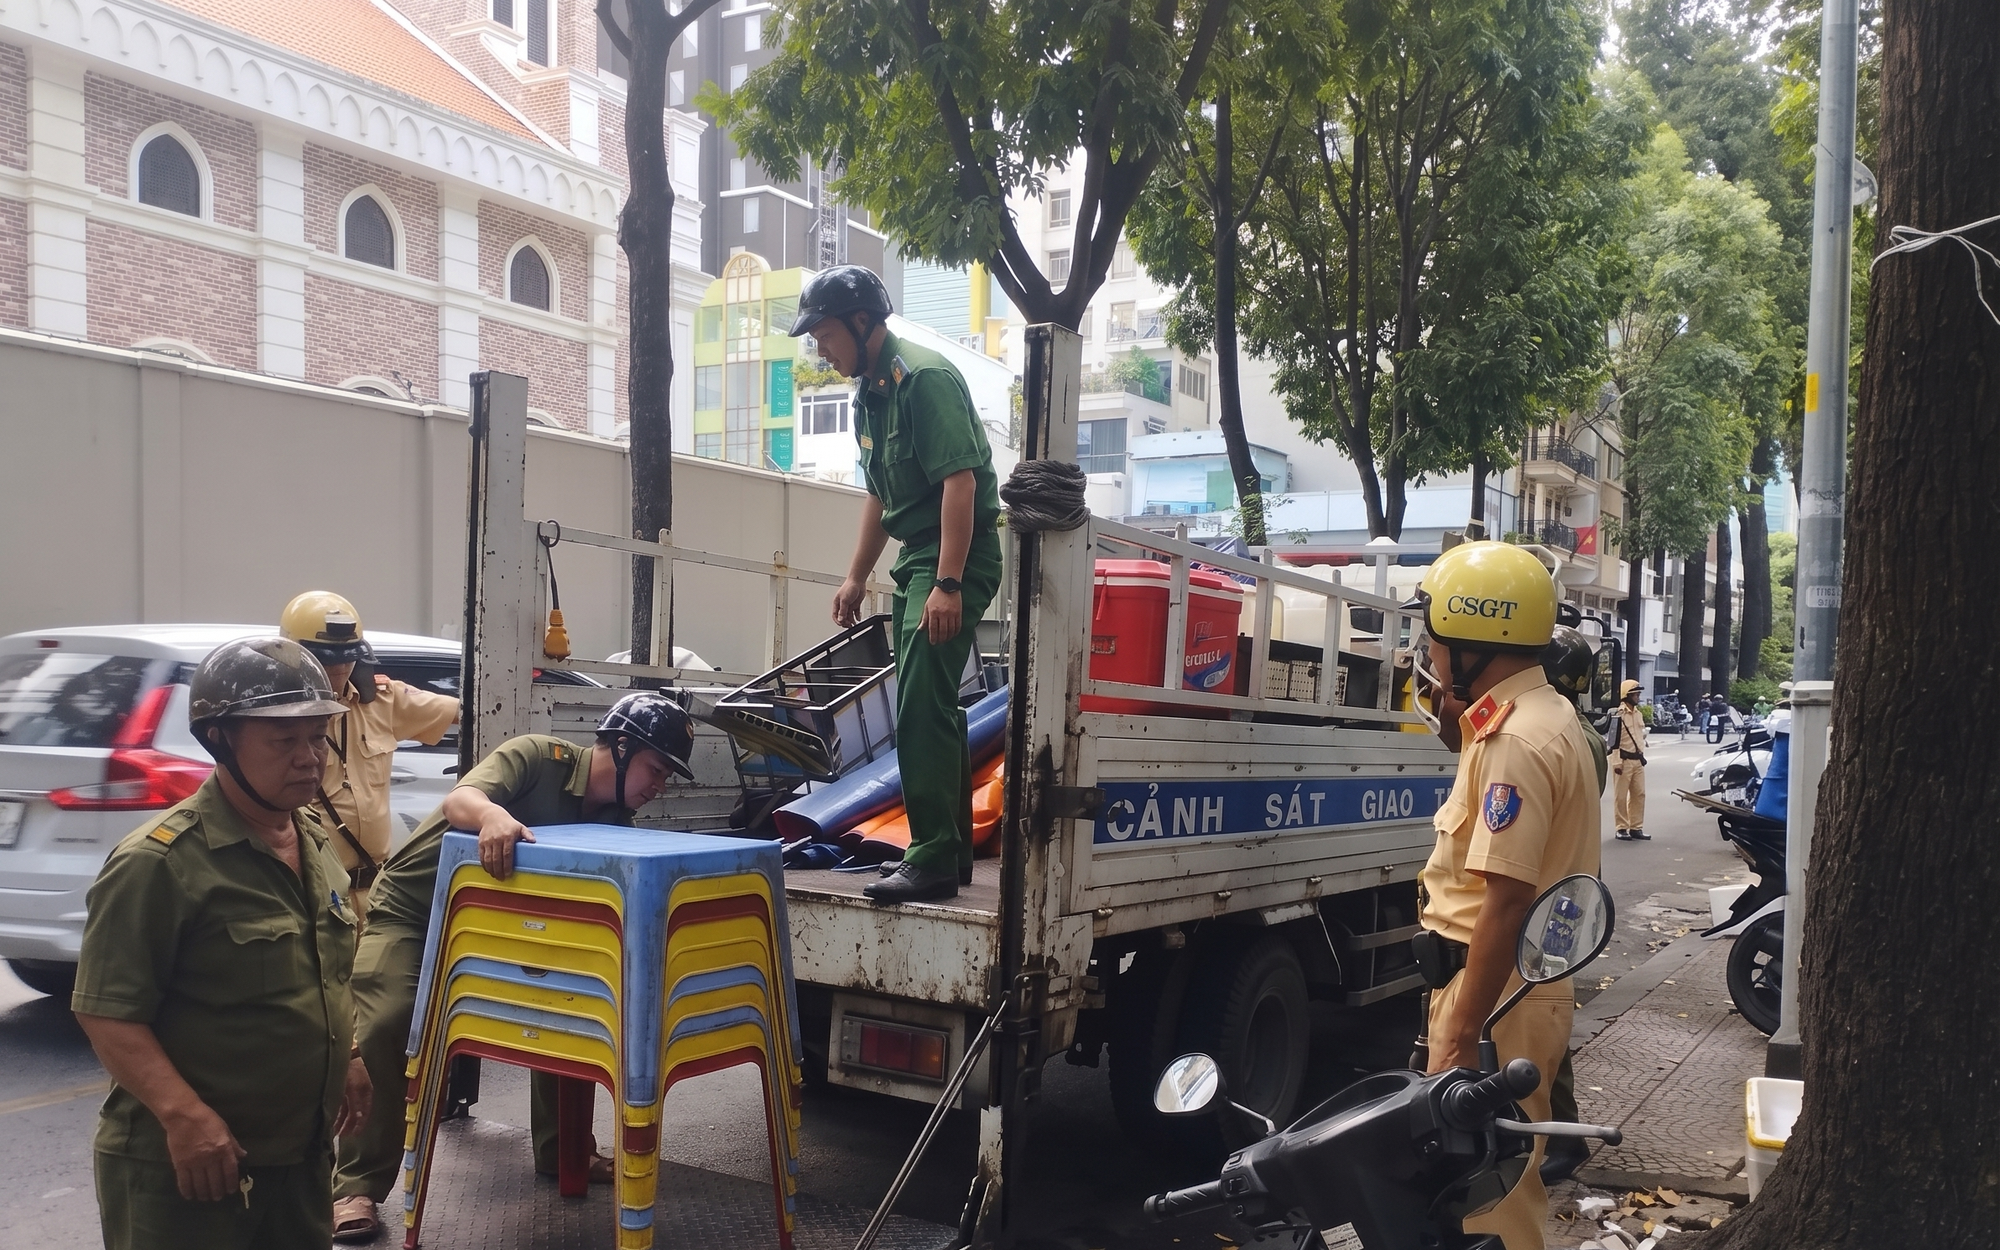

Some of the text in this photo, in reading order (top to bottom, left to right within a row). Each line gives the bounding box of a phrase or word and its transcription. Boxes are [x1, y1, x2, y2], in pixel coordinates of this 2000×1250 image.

[1447, 595, 1518, 620] CSGT
[1106, 782, 1224, 841] CẢNH
[1265, 783, 1327, 828] SÁT
[1361, 788, 1414, 820] GIAO
